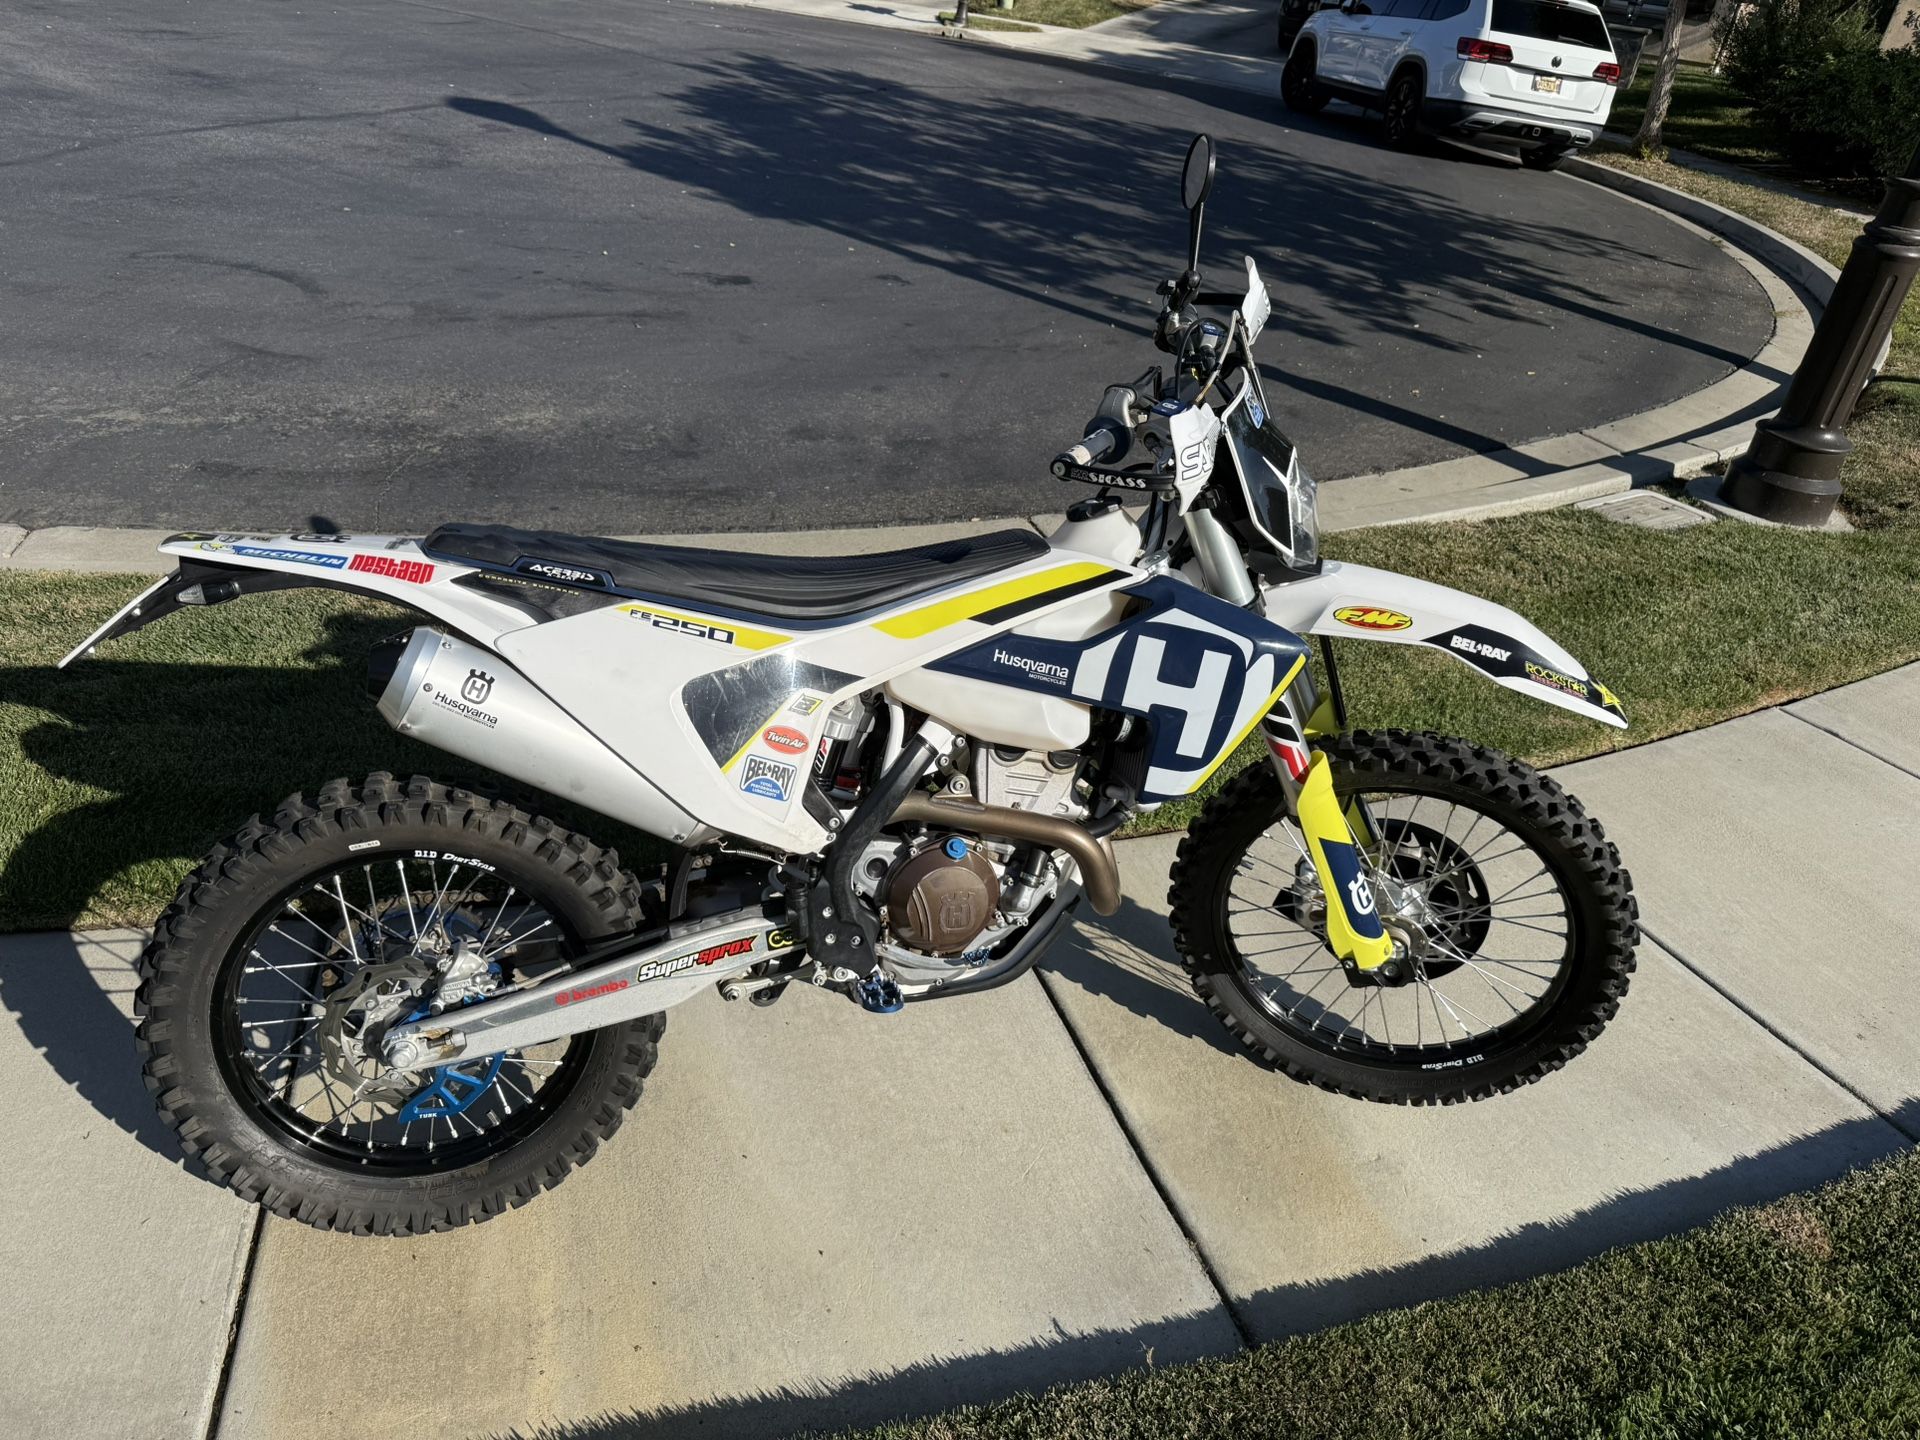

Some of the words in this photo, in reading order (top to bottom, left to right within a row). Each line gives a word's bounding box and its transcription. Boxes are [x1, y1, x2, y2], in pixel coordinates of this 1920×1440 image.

[1088, 472, 1146, 488] SICASS
[243, 548, 344, 566] MICHELIN
[529, 564, 595, 581] ACERBIS
[1336, 608, 1411, 626] FMF
[630, 609, 652, 621] FE
[652, 614, 734, 644] 250
[993, 648, 1069, 678] Husqvarna
[1028, 673, 1066, 686] MOTORCYCLES
[434, 691, 498, 725] Husqvarna
[573, 980, 629, 1001] brembo
